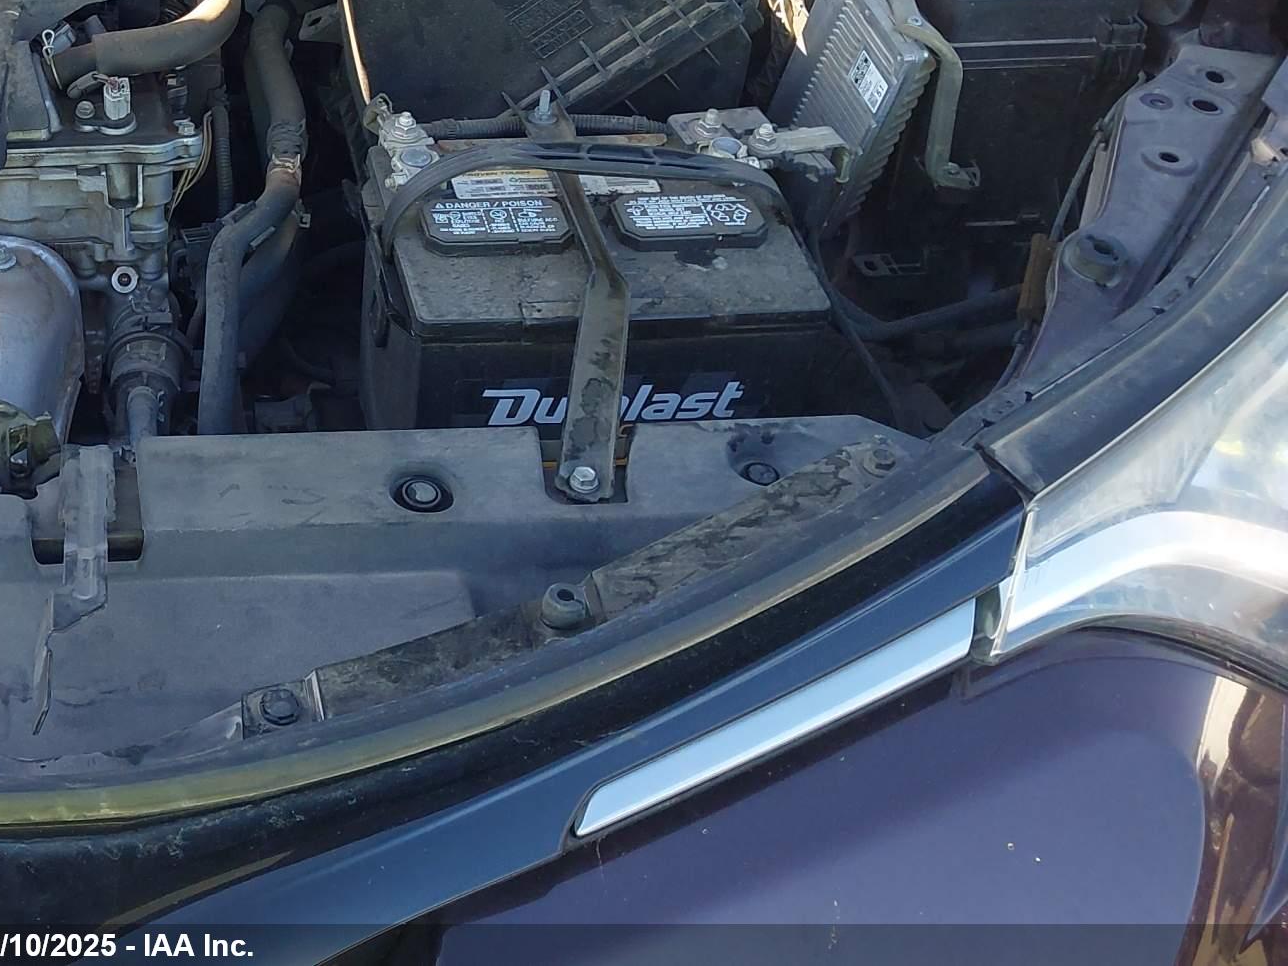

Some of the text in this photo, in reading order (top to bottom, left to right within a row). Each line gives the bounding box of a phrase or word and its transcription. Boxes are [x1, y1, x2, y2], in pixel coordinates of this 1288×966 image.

[445, 201, 490, 210] DANGER
[502, 199, 543, 208] POISON
[482, 381, 744, 426] Dulast
